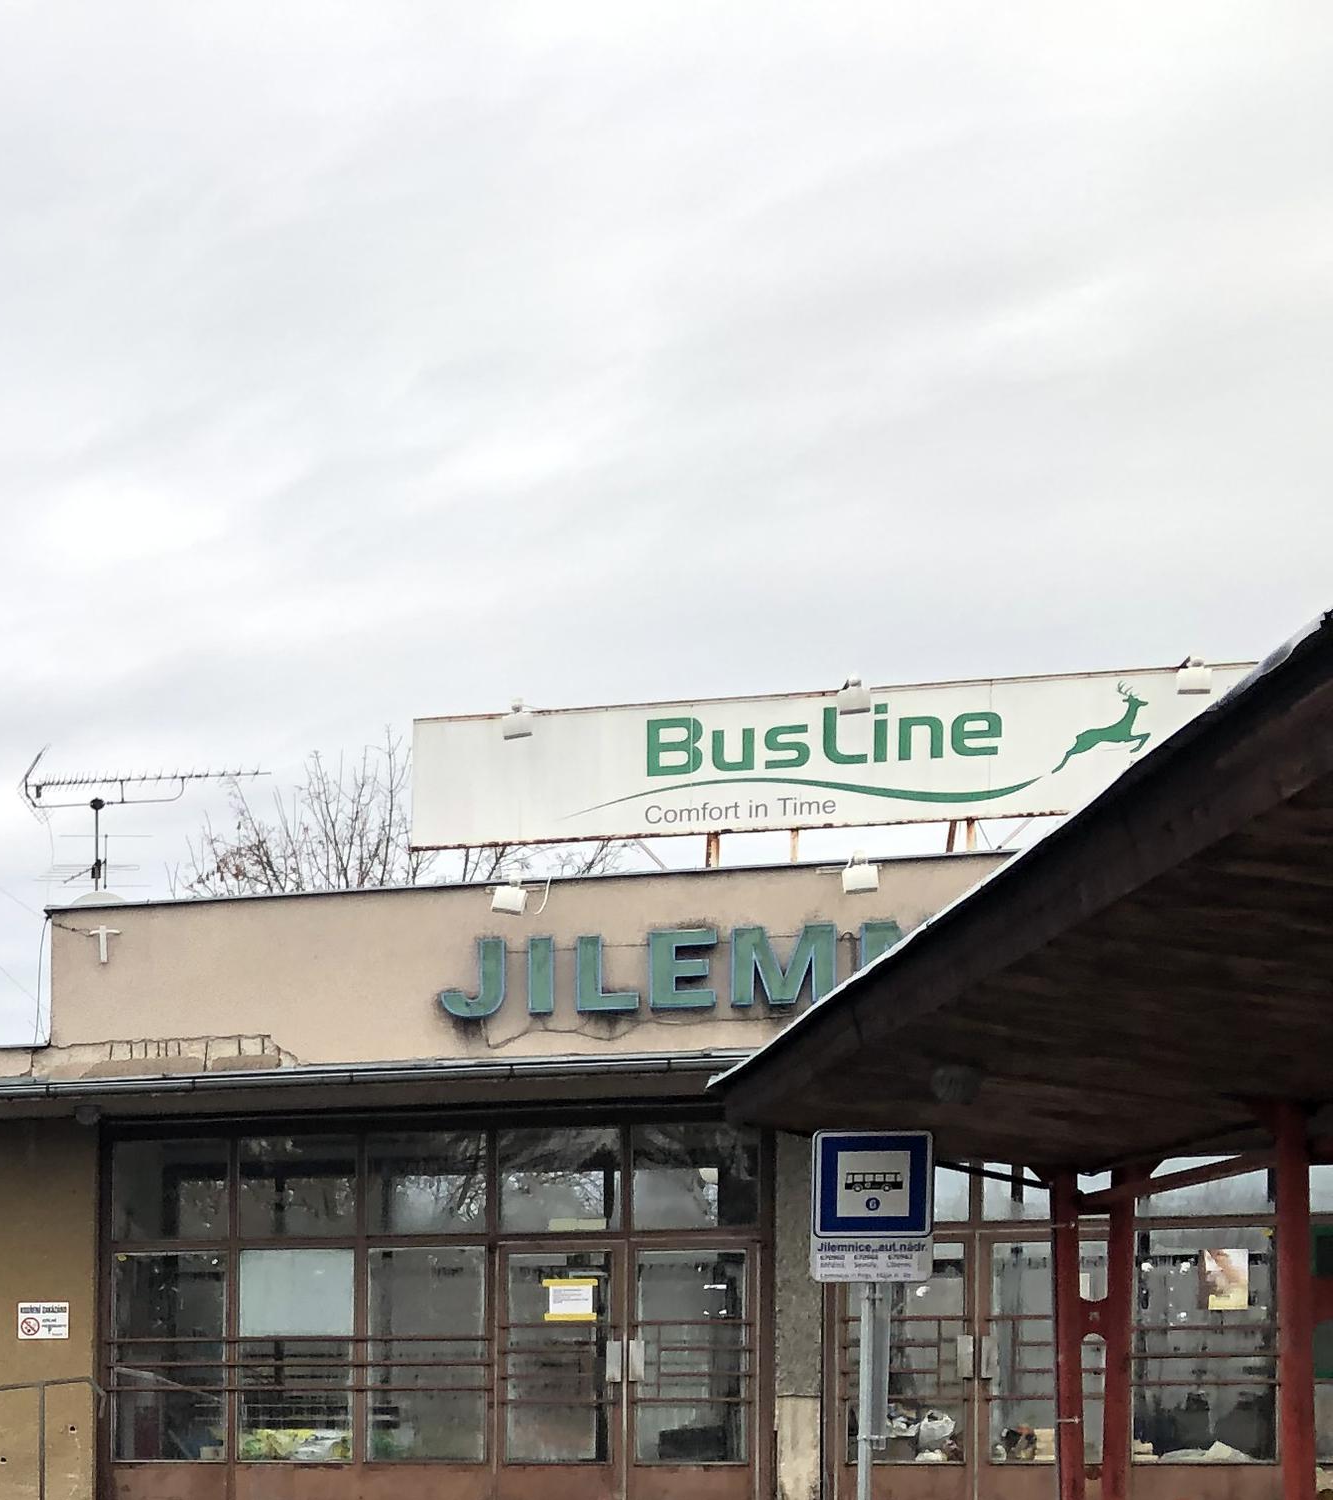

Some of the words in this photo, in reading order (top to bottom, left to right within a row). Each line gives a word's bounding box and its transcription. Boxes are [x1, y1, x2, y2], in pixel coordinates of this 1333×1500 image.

[644, 801, 741, 825] Comfort
[748, 800, 769, 819] in
[779, 796, 838, 817] Time
